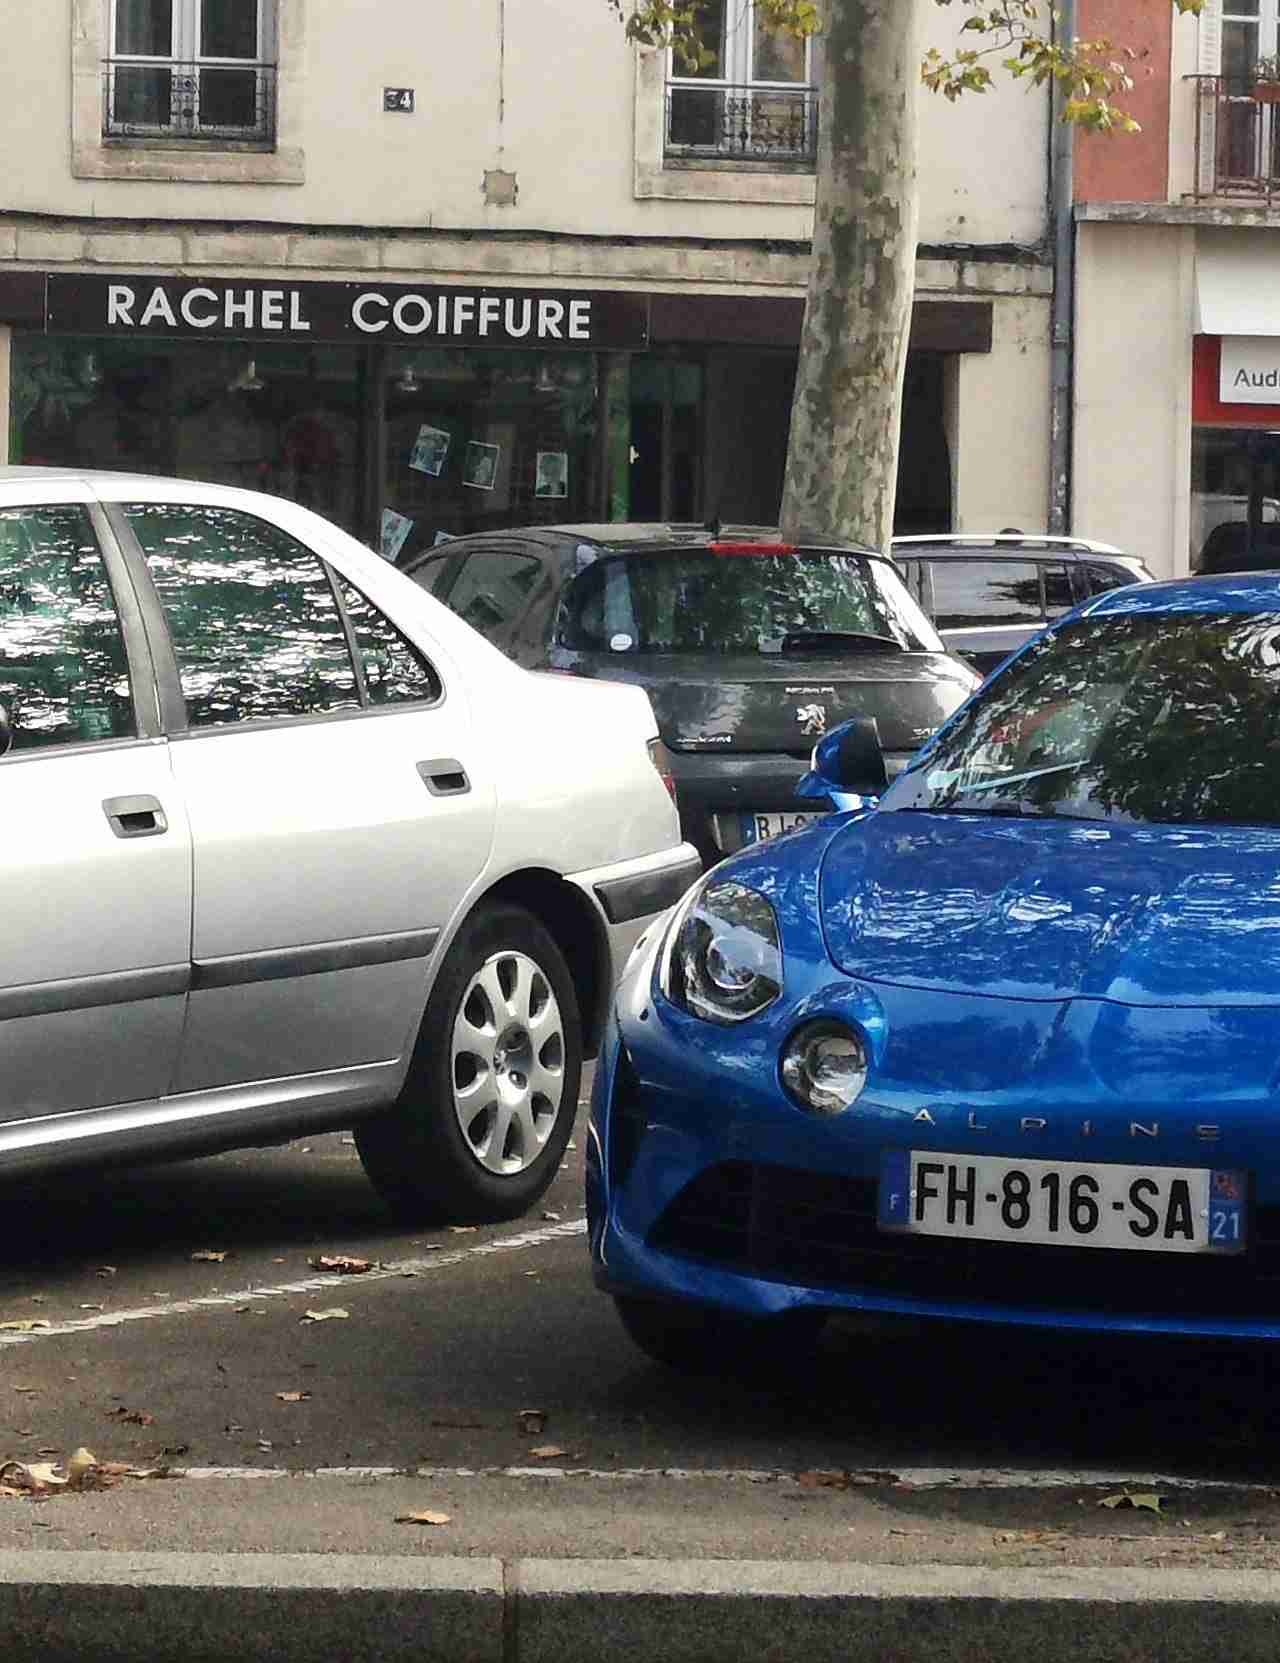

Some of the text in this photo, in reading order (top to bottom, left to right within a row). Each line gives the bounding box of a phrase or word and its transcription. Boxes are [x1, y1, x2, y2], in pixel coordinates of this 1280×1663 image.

[107, 284, 592, 339] RACHEL COIFFURE
[913, 1107, 1221, 1141] ALPINE
[915, 1162, 1195, 1241] FH-816-SA
[1211, 1211, 1241, 1240] 21
